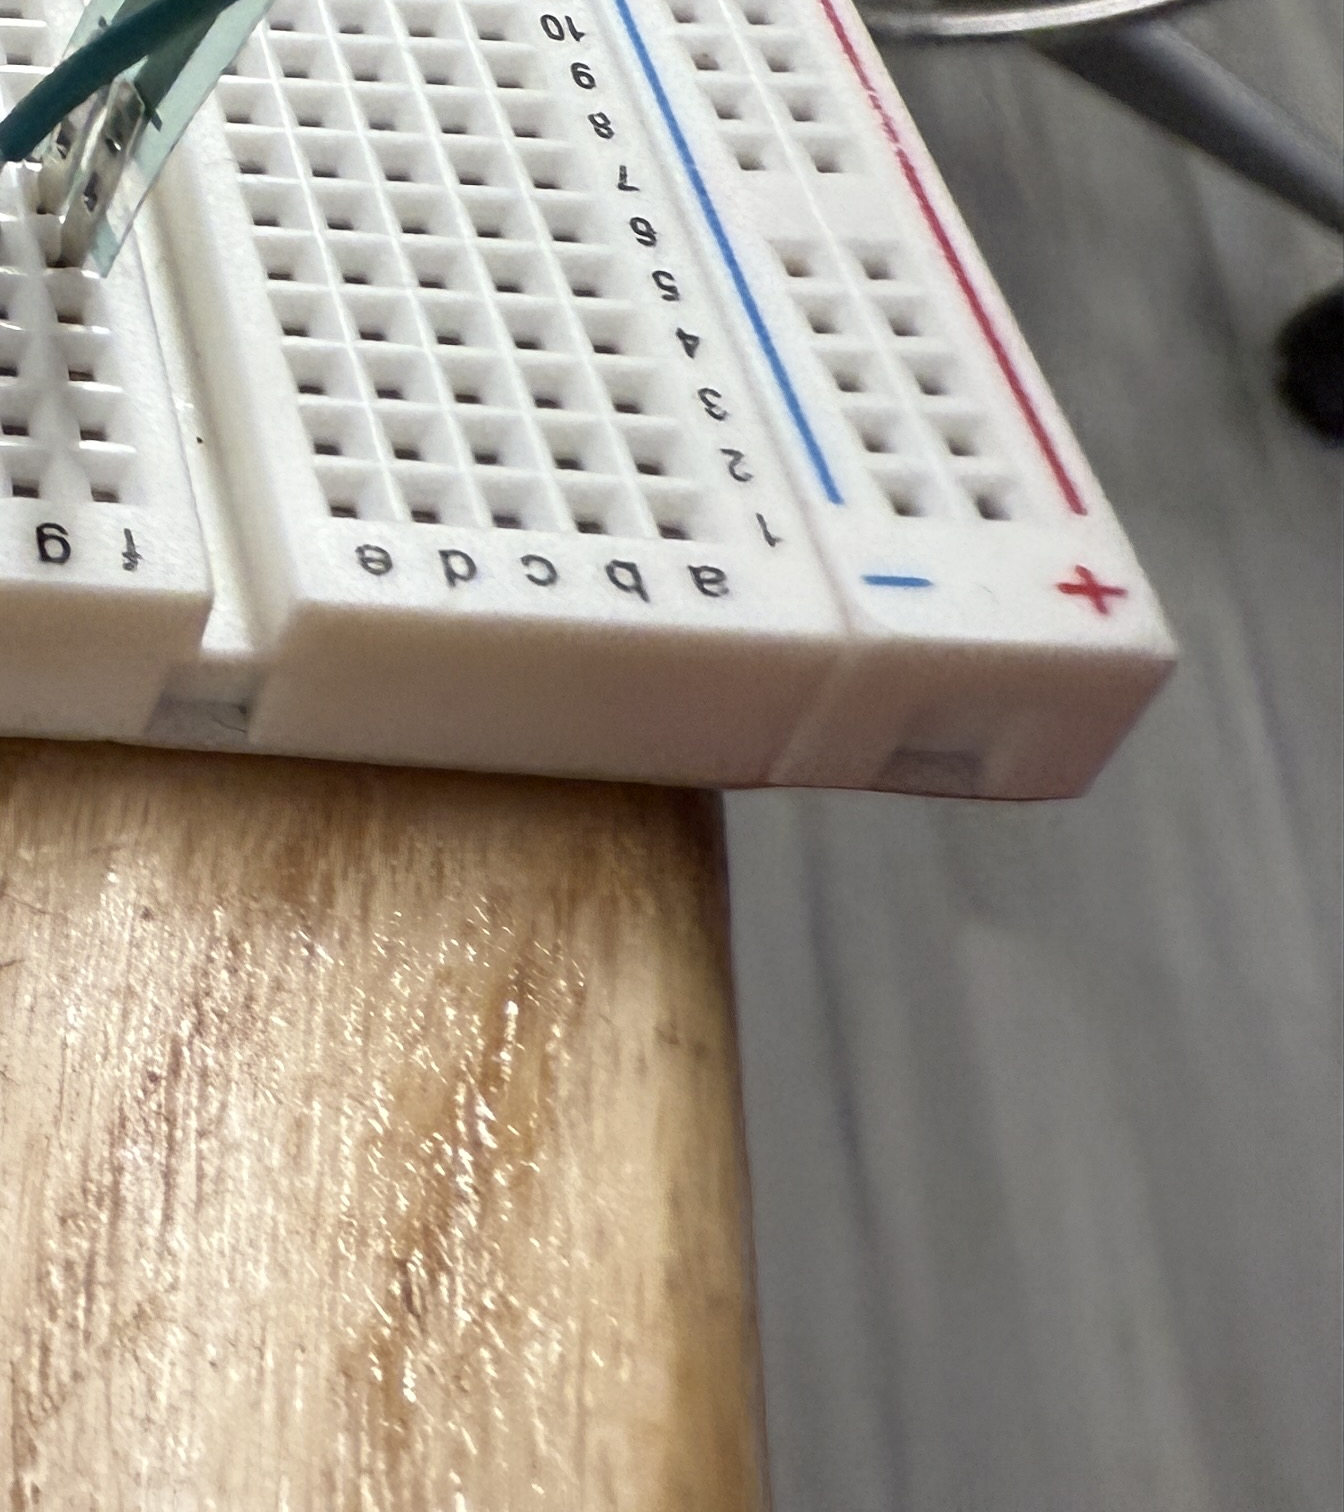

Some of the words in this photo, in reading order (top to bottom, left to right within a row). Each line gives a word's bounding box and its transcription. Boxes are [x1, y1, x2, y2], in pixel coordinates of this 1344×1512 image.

[540, 14, 586, 42] 10
[570, 62, 597, 89] 9
[587, 112, 615, 139] 8
[617, 165, 640, 191] 7
[651, 269, 681, 302] 5
[675, 327, 701, 359] 4
[697, 387, 728, 421] 3
[720, 448, 753, 482] 2
[36, 522, 71, 564] g
[755, 512, 783, 547] 1
[122, 528, 142, 572] f
[355, 544, 393, 576] e
[439, 548, 477, 587] d
[520, 553, 559, 586] c
[606, 559, 650, 603] b
[688, 563, 729, 597] a
